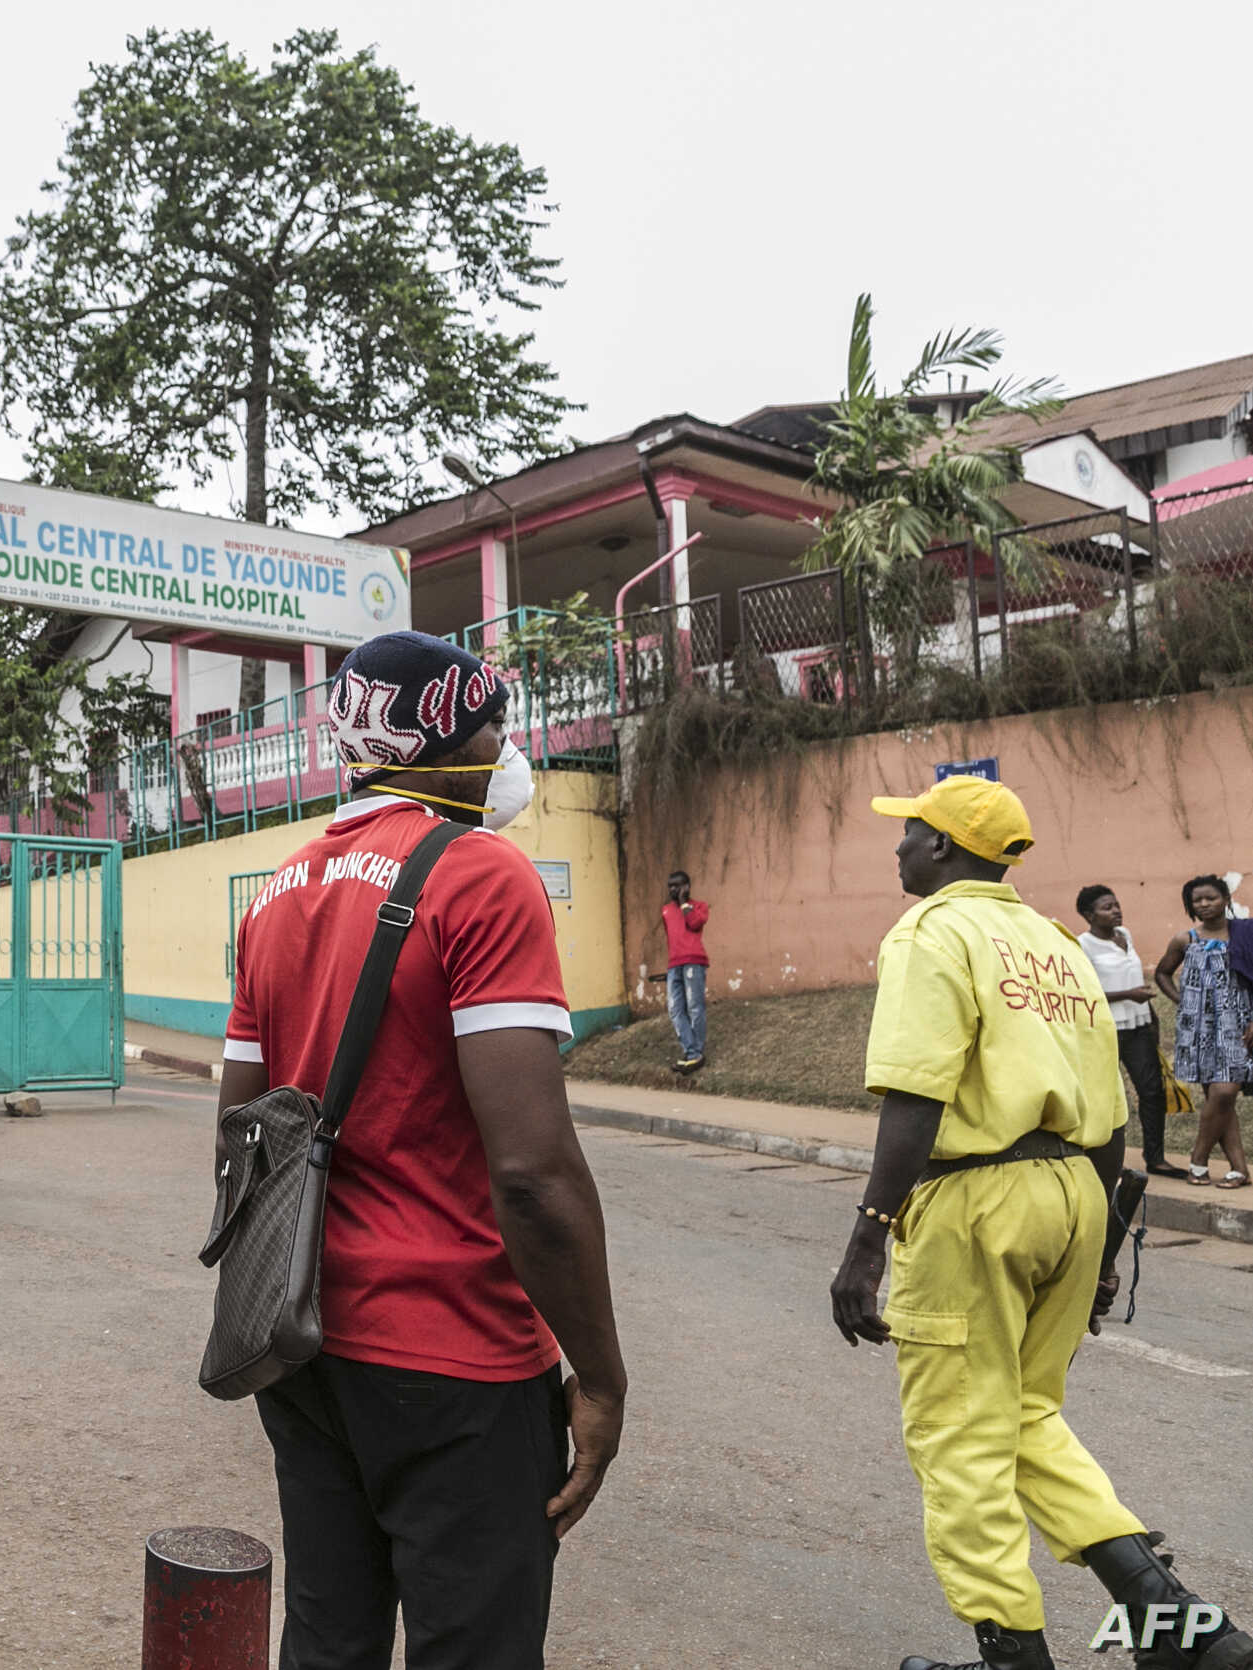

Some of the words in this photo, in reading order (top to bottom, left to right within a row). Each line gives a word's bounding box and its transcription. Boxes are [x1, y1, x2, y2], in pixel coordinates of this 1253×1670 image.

[37, 521, 173, 571] CENTRAL
[182, 543, 216, 577] DE
[226, 552, 347, 597] YAOUNDE
[224, 539, 265, 554] MINISTRY
[268, 546, 279, 556] OF
[282, 549, 311, 563] PUBLIC
[314, 553, 346, 568] HEALTH
[91, 565, 196, 606] CENTRAL
[203, 582, 306, 621] HOSPITAL
[252, 860, 310, 920] BAYERN
